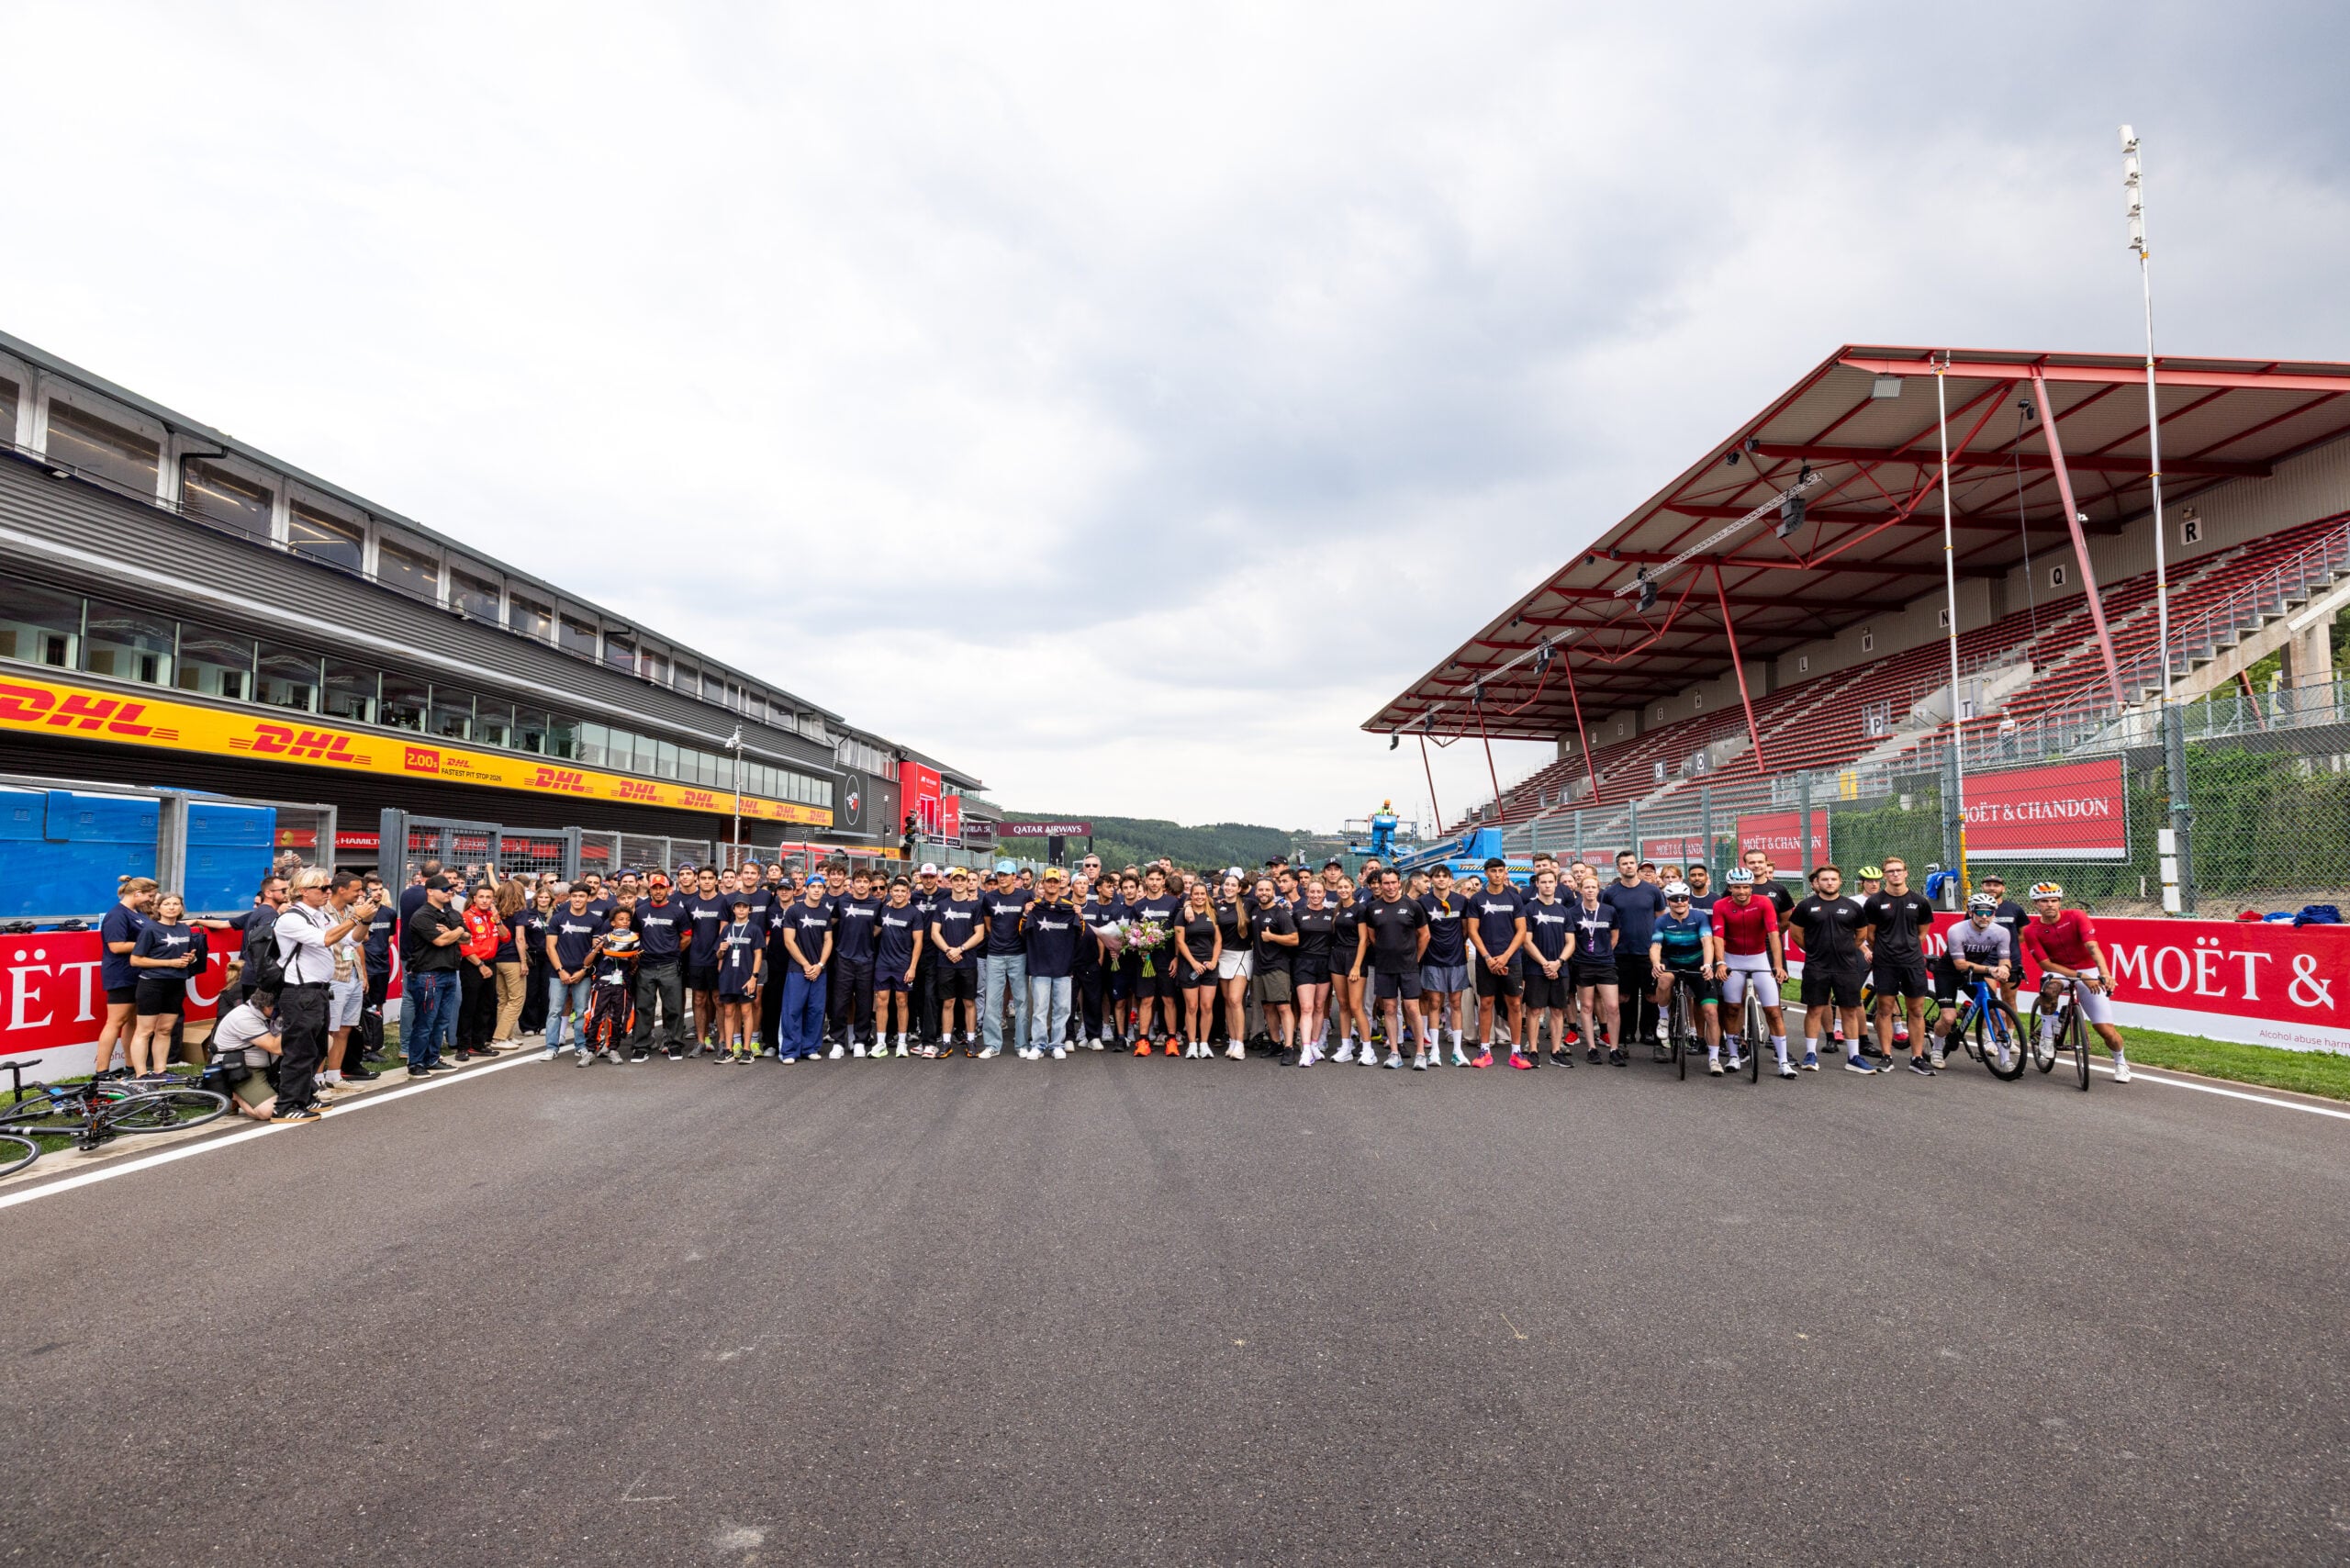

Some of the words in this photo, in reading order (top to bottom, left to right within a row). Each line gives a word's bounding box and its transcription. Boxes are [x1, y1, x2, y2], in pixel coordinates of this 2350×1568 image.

[2185, 521, 2197, 543] R
[2053, 567, 2063, 585] Q
[1942, 610, 1949, 626] N
[1864, 635, 1872, 650] M
[1801, 658, 1807, 671] L
[0, 684, 152, 736] DHL
[1962, 700, 1971, 718] T
[1873, 718, 1882, 734] P
[251, 723, 356, 763] DHL
[446, 757, 470, 768] DHL
[1656, 763, 1662, 776] K
[441, 767, 465, 778] FASTEST
[476, 772, 489, 780] STOP
[534, 767, 585, 792] DHL
[619, 780, 657, 801] DHL
[683, 790, 714, 808] DHL
[2003, 803, 2015, 821] &
[2017, 797, 2109, 820] CHANDON
[1013, 825, 1043, 834] QATAR
[1045, 825, 1082, 834] AIRWAYS
[341, 837, 380, 846] HAMILT
[1742, 835, 1766, 850] MOËT
[1767, 837, 1774, 849] &
[2110, 936, 2272, 1001] MOËT
[2288, 954, 2334, 1010] &
[2259, 1029, 2291, 1041] Alcohol
[2294, 1035, 2322, 1046] abuse
